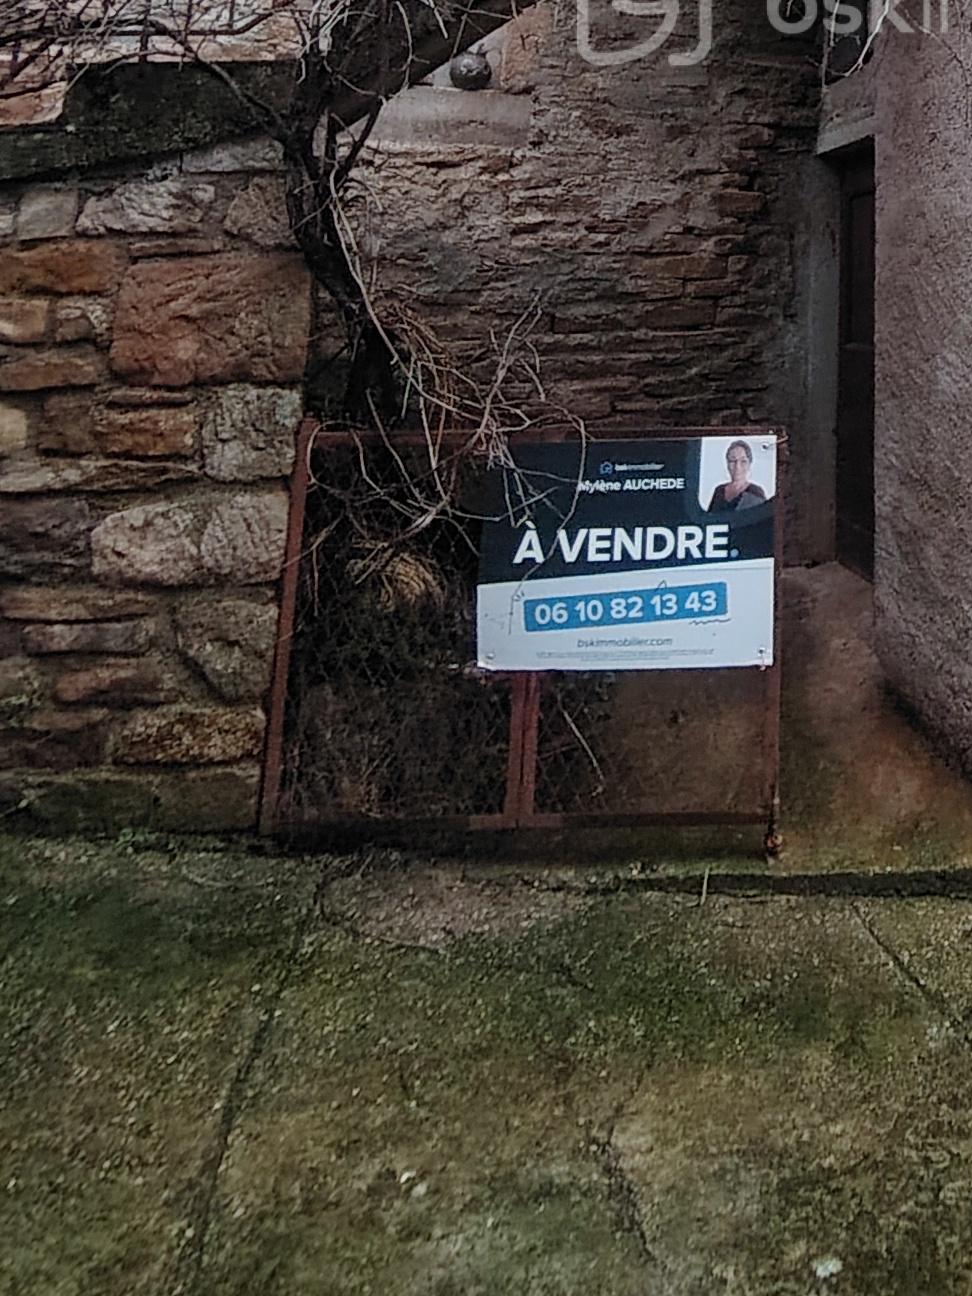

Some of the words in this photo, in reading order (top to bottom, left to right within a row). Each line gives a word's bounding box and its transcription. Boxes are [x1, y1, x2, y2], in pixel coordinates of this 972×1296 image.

[622, 477, 686, 491] AUCHEDE
[512, 520, 545, 564] À
[556, 524, 739, 563] VENDRE.
[534, 602, 568, 625] 06
[574, 599, 604, 622] 10
[609, 596, 644, 620] 82
[650, 593, 678, 616] 13
[684, 590, 717, 613] 43
